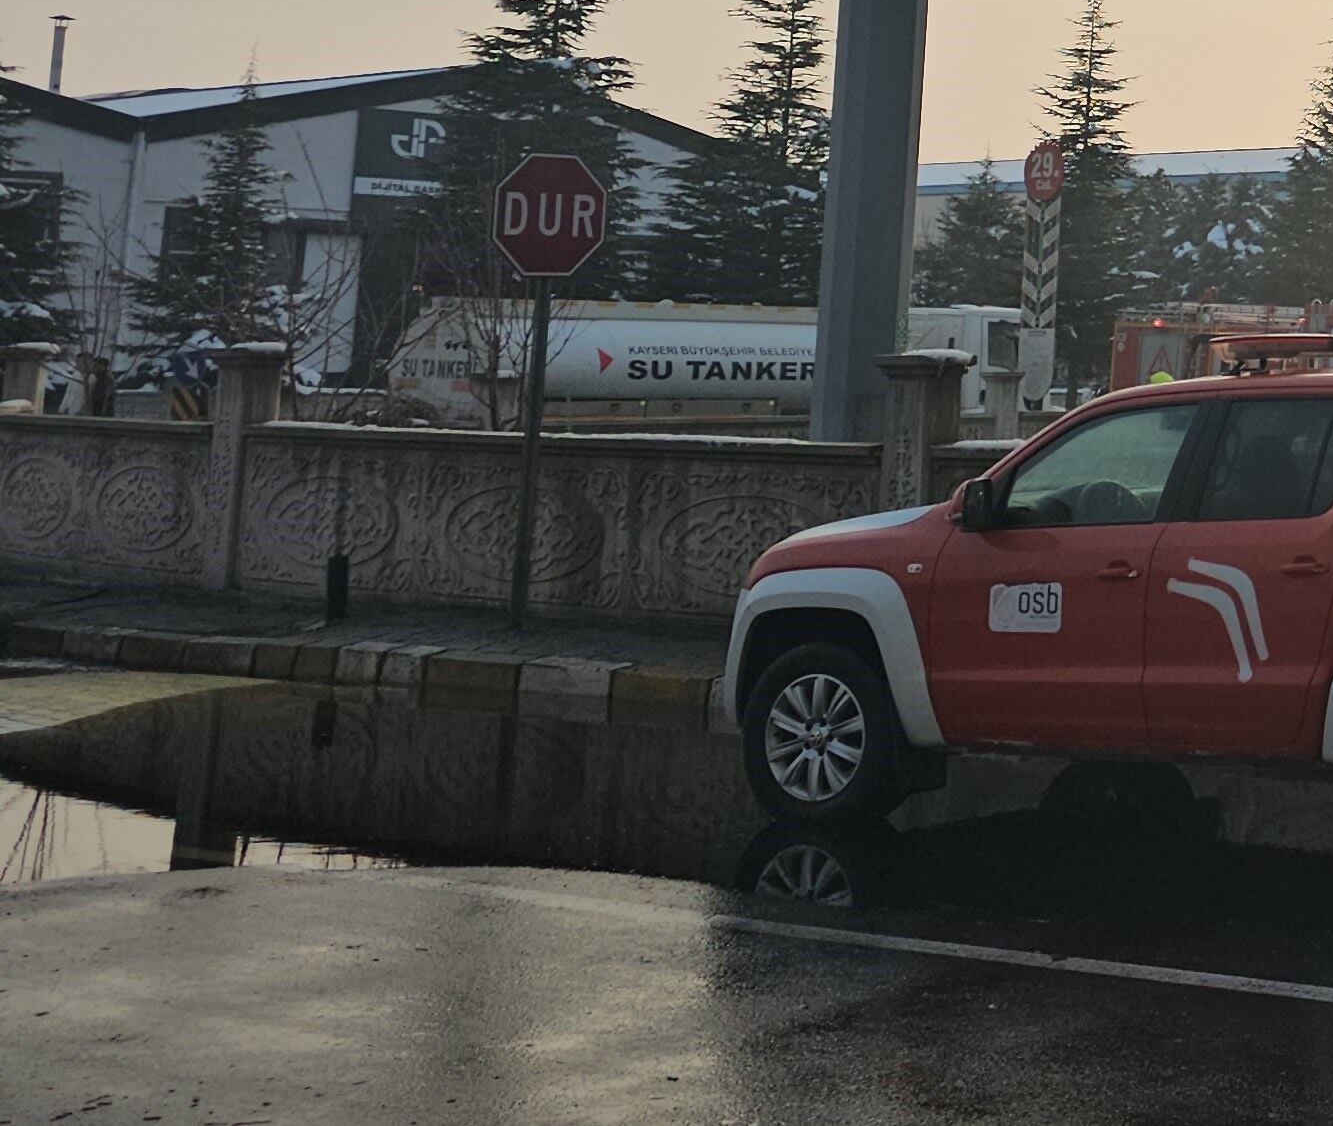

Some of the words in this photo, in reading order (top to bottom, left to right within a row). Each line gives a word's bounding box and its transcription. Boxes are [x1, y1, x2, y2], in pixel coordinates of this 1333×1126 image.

[503, 191, 596, 238] DUR
[628, 360, 673, 380] SU
[1018, 584, 1059, 614] osb
